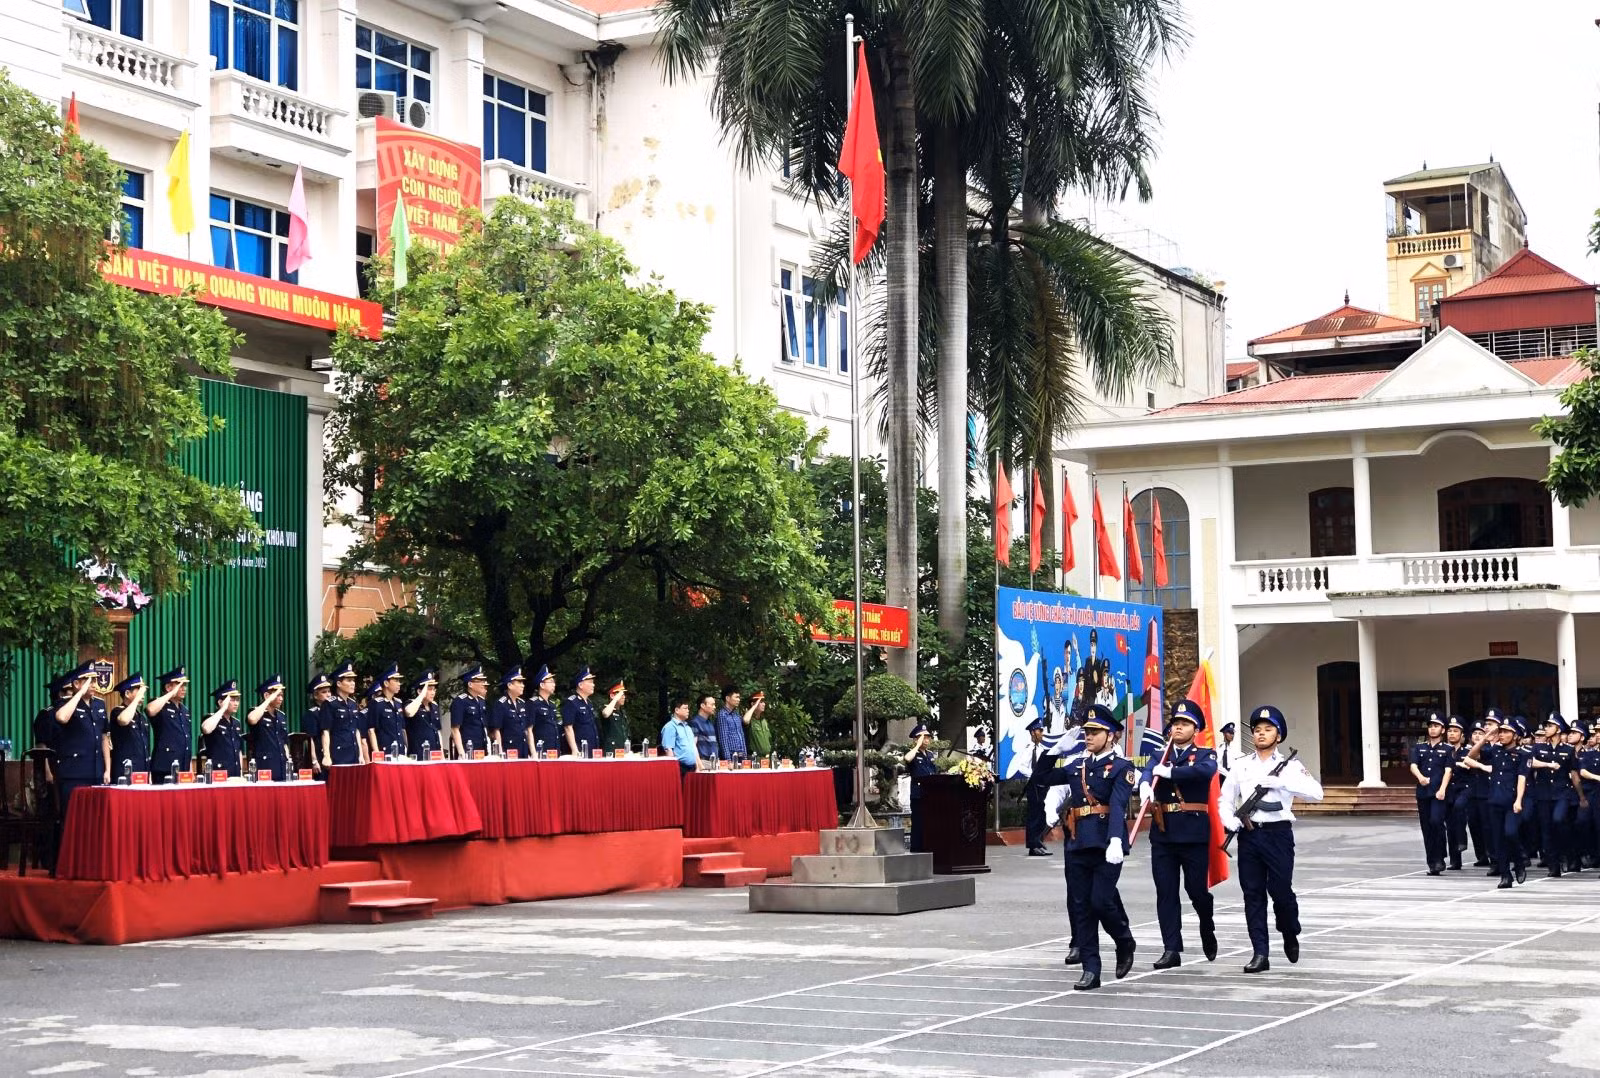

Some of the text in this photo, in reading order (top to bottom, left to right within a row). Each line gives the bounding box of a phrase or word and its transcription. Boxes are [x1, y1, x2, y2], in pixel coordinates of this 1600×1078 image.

[403, 148, 458, 181] XÂY DỰNG
[401, 176, 426, 199] CON
[405, 203, 458, 234] VIỆT NAM
[137, 259, 169, 288] VIỆT
[172, 266, 206, 290] NAM
[209, 274, 255, 304] QUANG
[258, 286, 289, 312] VINH
[292, 294, 330, 321] MUÔN
[332, 301, 361, 328] NĂM
[265, 526, 285, 547] KHÓA
[285, 531, 297, 548] VIII
